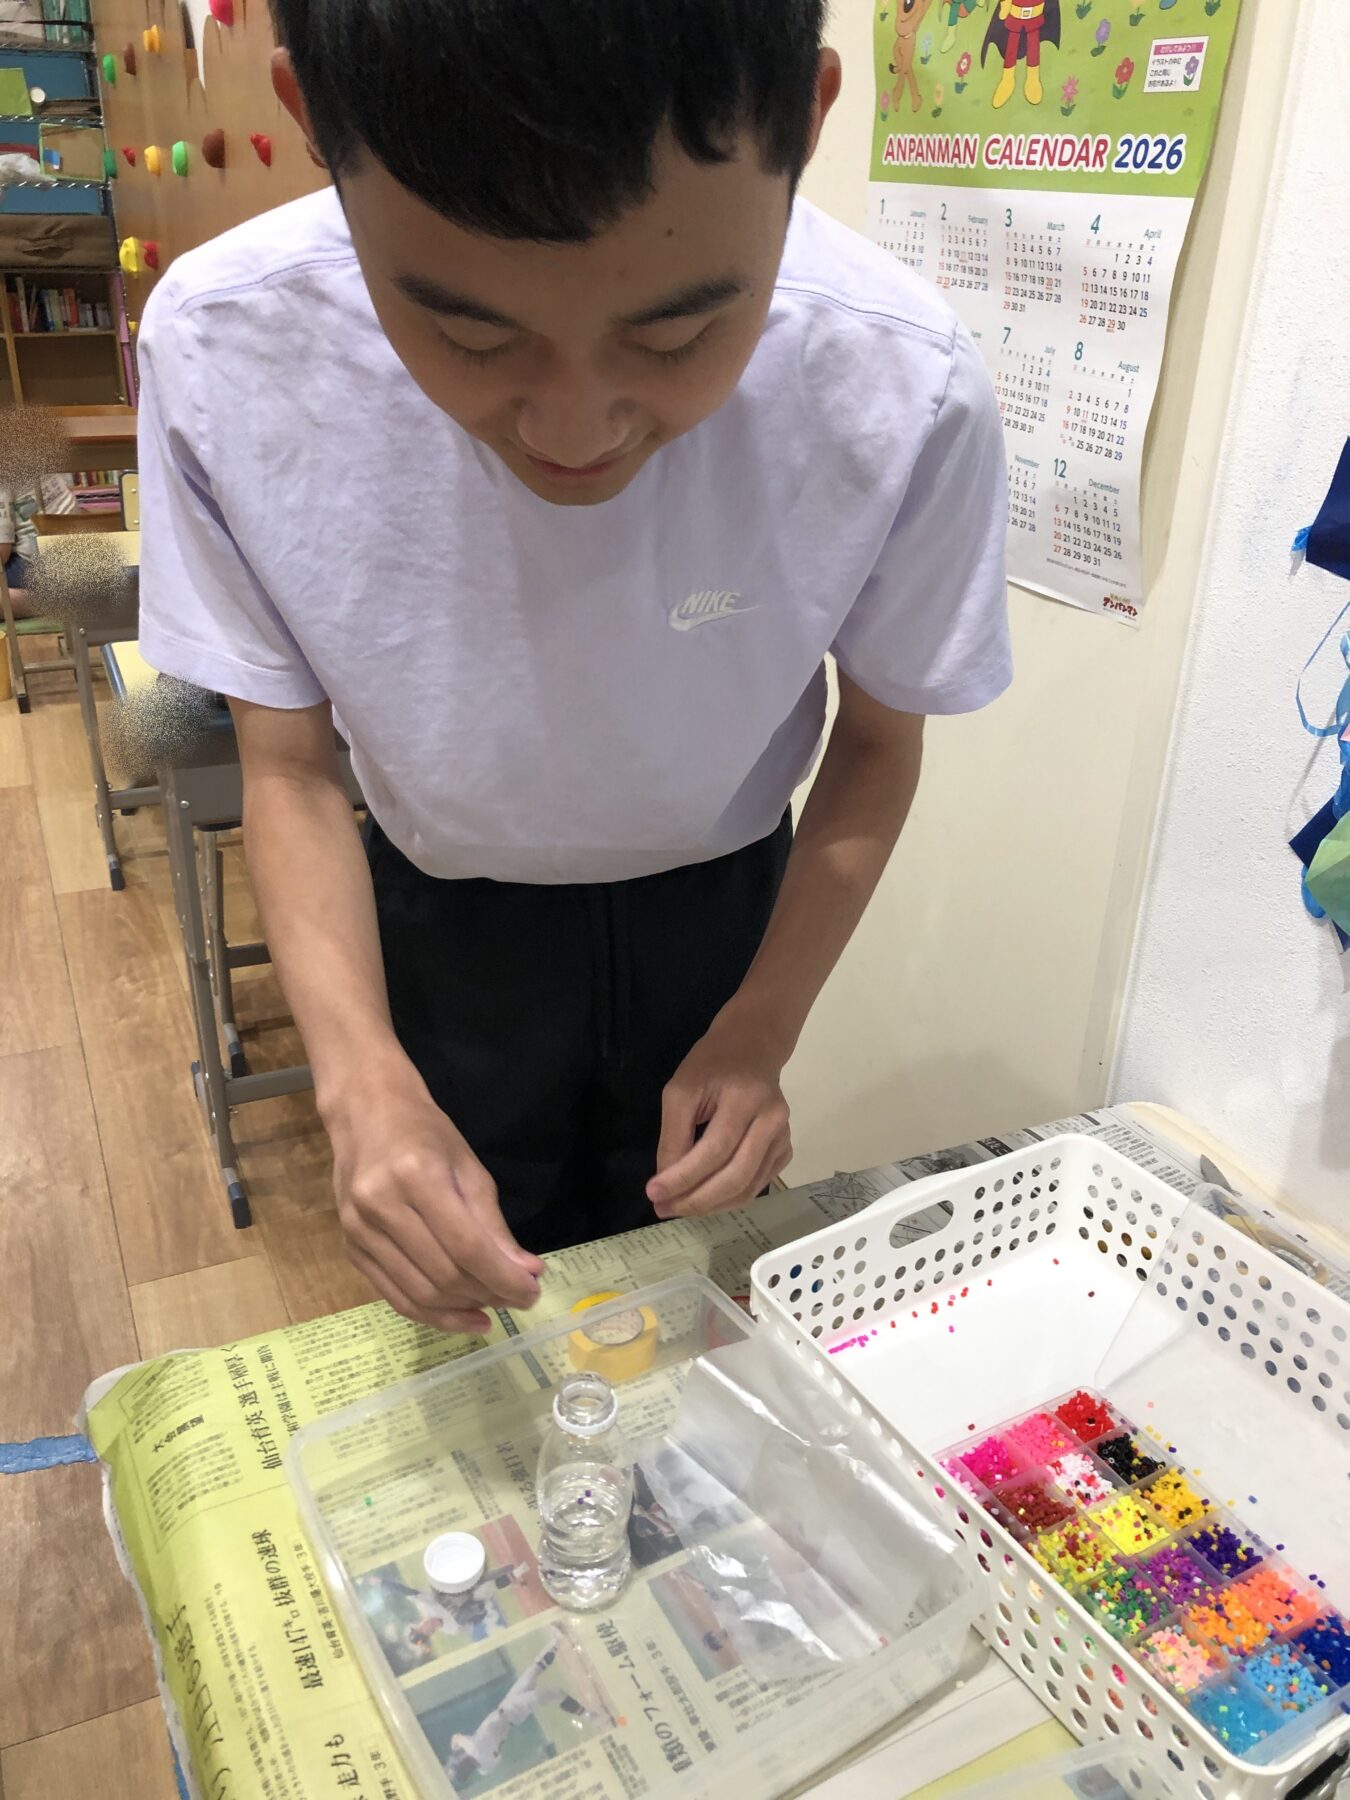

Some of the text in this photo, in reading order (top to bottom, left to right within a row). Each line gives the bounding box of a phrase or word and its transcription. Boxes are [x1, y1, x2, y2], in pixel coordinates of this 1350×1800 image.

[884, 138, 1184, 170] ANPANMAN CALENDAR 2026
[880, 198, 885, 215] 1
[941, 203, 947, 220] 2
[1005, 208, 1065, 231] 3 March
[1091, 214, 1162, 240] 4 April
[1132, 273, 1140, 282] 10
[1143, 274, 1150, 284] 11
[1081, 283, 1149, 301] 12 13 14 15 16 17 18
[1081, 299, 1148, 317] 19 20 21 22 23 24 25
[1080, 314, 1125, 330] 26 27 28 29 30
[1003, 327, 1011, 344] 7
[1075, 342, 1140, 373] 8 August
[1073, 408, 1080, 417] 10
[1091, 412, 1098, 422] 12
[1101, 415, 1108, 425] 13
[1110, 418, 1117, 427] 14
[1120, 420, 1127, 430] 15
[1071, 422, 1078, 432] 17
[1080, 425, 1086, 434] 18
[1089, 427, 1096, 437] 19
[1097, 430, 1105, 440] 20
[1106, 433, 1114, 442] 21
[1116, 436, 1124, 445] 22
[1077, 440, 1084, 450] 25
[1086, 443, 1093, 452] 26
[1095, 445, 1103, 455] 27
[1105, 448, 1112, 458] 28
[1114, 451, 1122, 461] 29
[1054, 458, 1066, 478] 12
[1088, 478, 1120, 495] December
[1054, 518, 1121, 546] 13 14 15 16 17 18 19
[1093, 516, 1100, 526] 10
[1102, 519, 1110, 528] 11
[1113, 522, 1120, 532] 12
[1054, 531, 1122, 560] 20 21 22 23 24 25 26
[1054, 545, 1100, 567] 27 28 29 30 31
[680, 590, 741, 614] NIKE
[1103, 596, 1139, 616] アンパンマン
[255, 1342, 302, 1437] 和学園は主戦に期待
[219, 1342, 283, 1472] 仙台育英 選手層厚く
[250, 1526, 296, 1609] 抜群の速球
